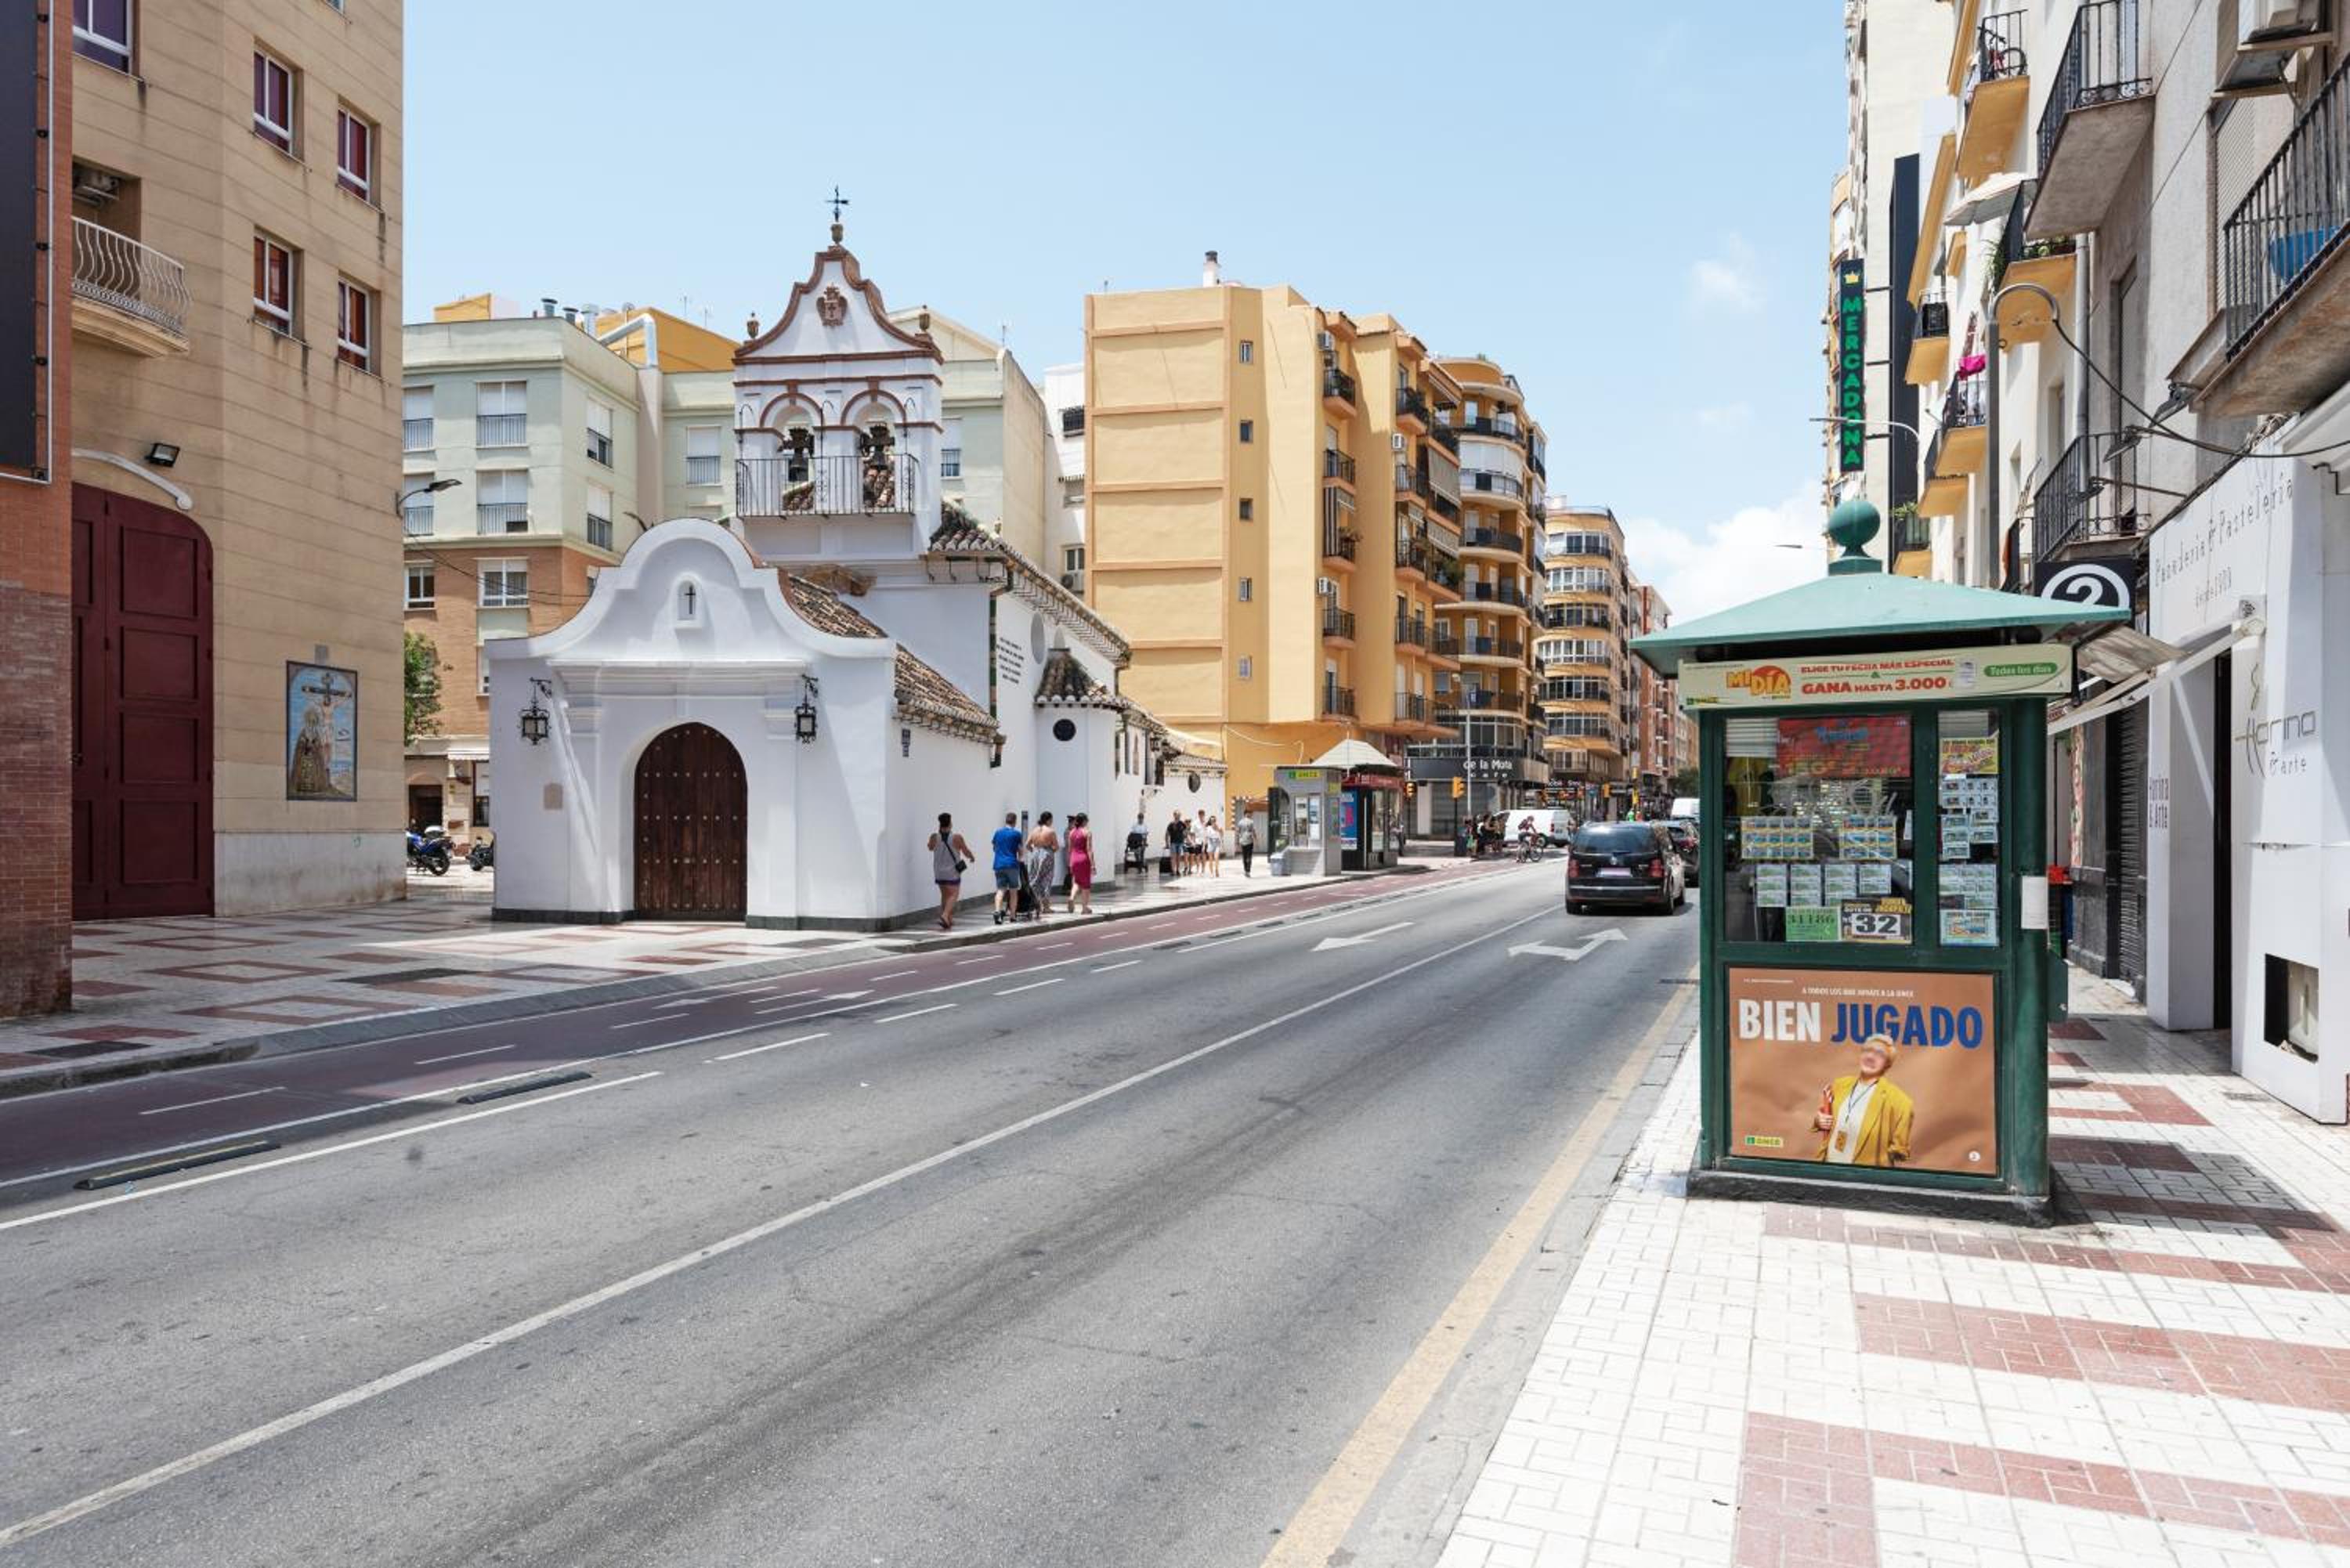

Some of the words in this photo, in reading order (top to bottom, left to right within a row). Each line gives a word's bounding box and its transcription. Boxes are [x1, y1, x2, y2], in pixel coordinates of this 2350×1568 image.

[1842, 295, 1862, 464] MERCADONA
[1802, 681, 1853, 695] GANA
[1855, 683, 1893, 692] HASTA
[1895, 677, 1947, 691] 3.000
[1480, 759, 1489, 770] la
[1491, 759, 1513, 770] Mota
[1855, 914, 1898, 934] 32
[1738, 999, 1821, 1042] BIEN
[1831, 1003, 1983, 1050] JUGADO
